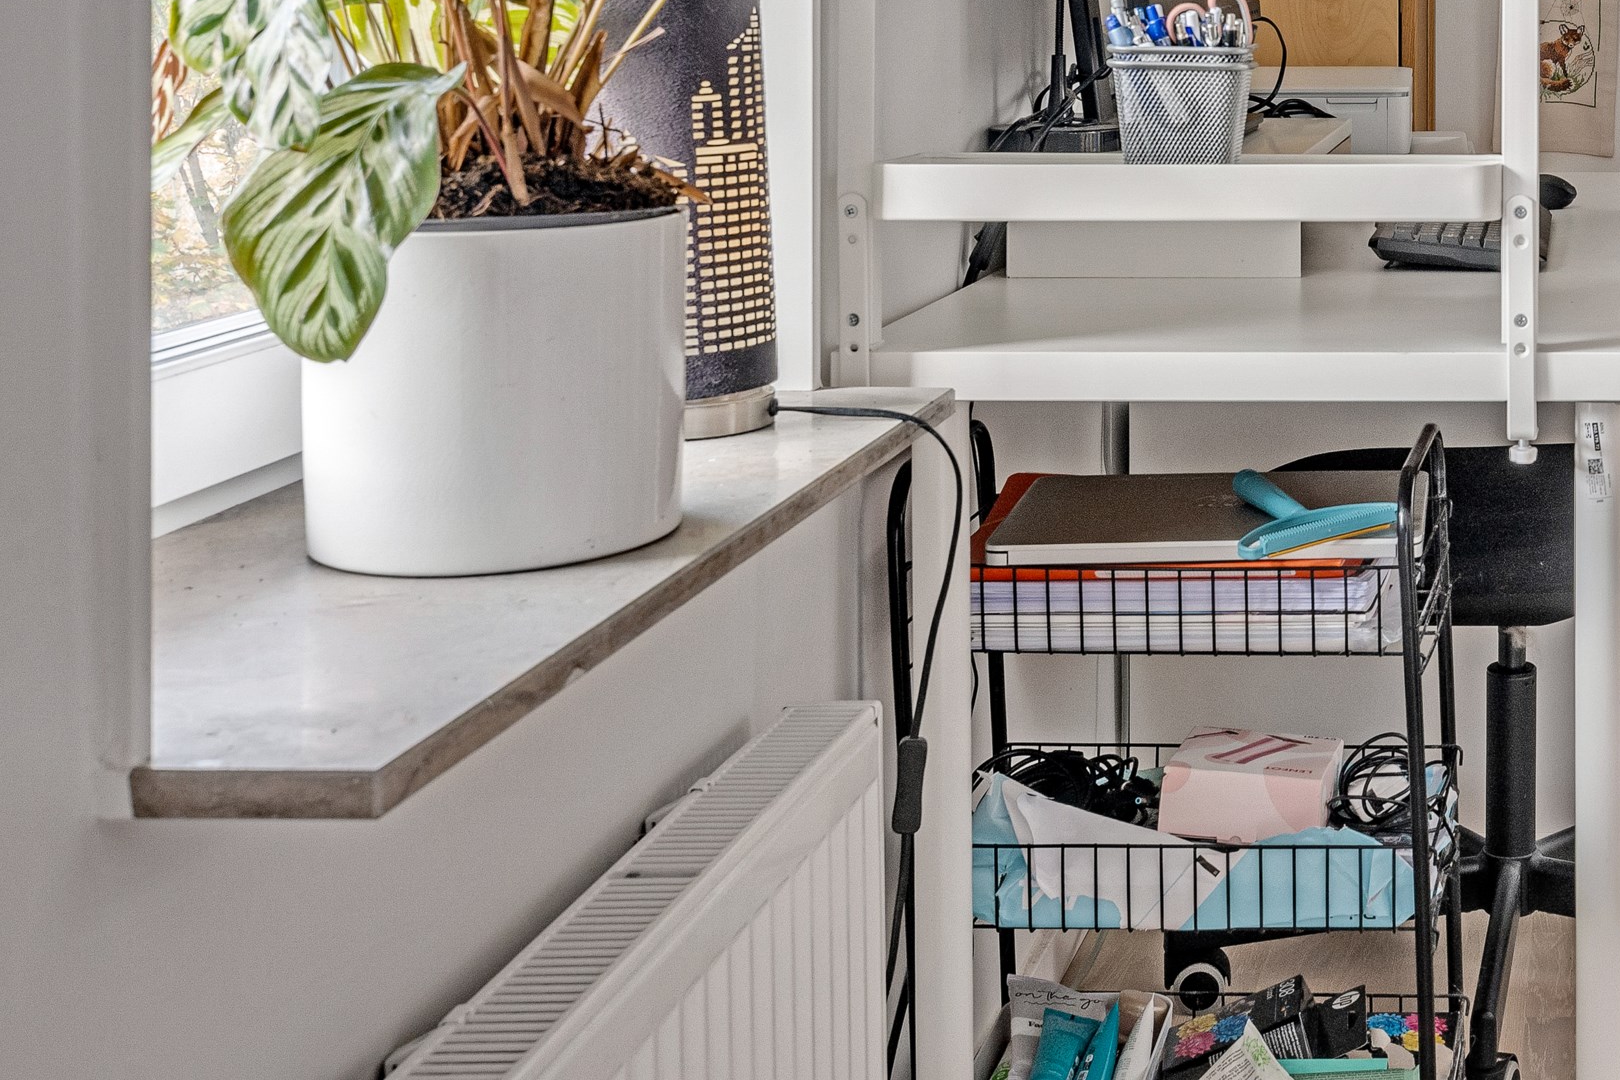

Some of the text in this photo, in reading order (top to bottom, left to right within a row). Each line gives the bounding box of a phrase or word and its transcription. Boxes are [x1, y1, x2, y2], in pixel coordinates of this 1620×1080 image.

[1278, 978, 1296, 999] 308
[1014, 990, 1104, 1010] on the go
